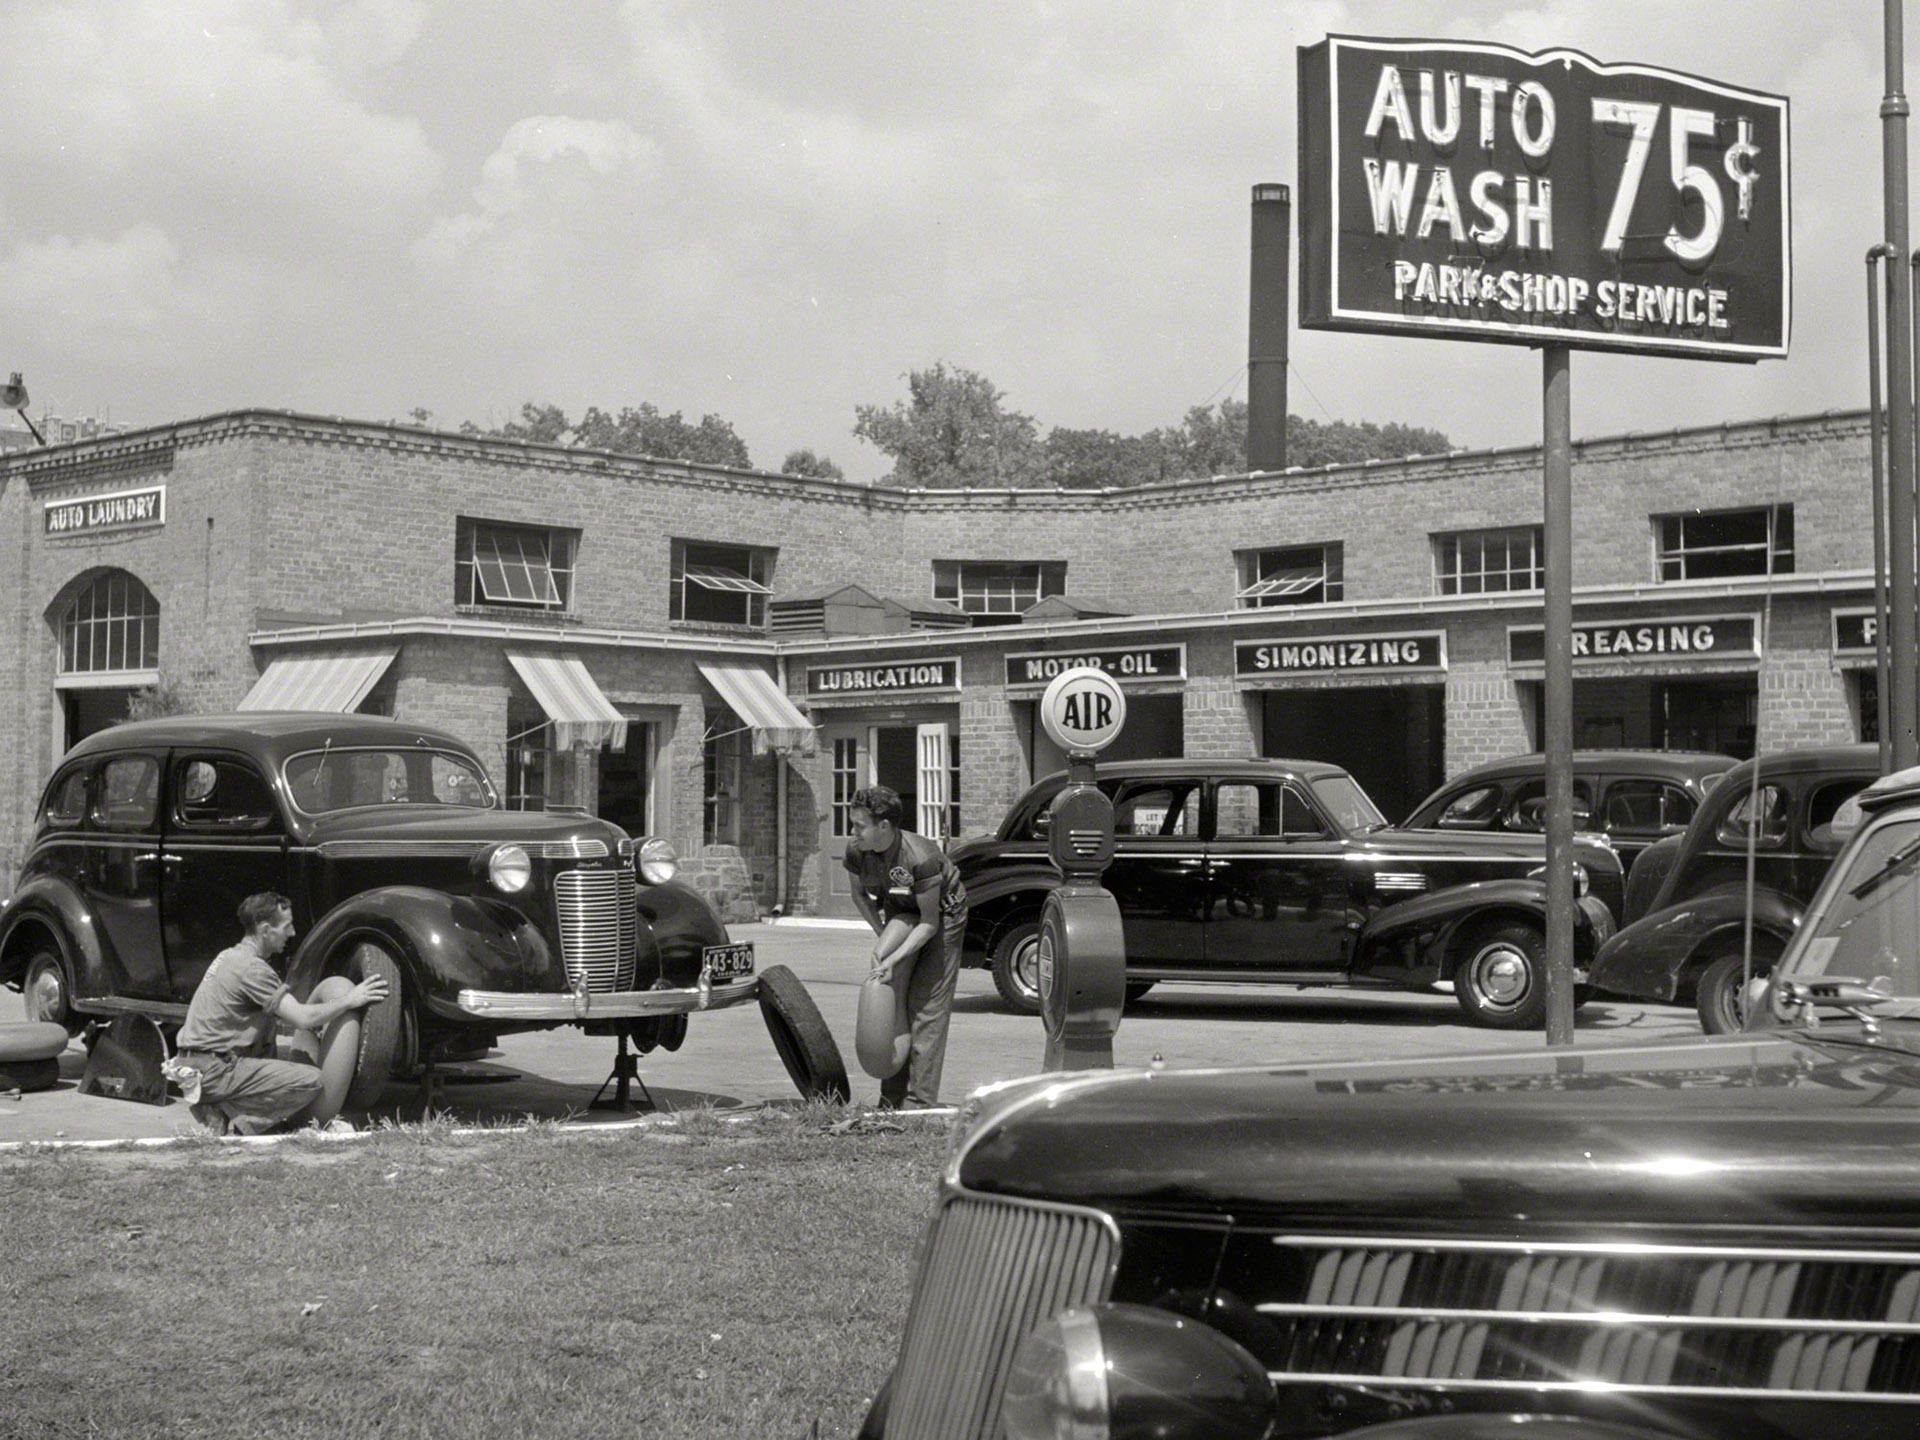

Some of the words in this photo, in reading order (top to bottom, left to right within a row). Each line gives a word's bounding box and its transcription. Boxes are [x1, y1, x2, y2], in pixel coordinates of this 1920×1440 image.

[1364, 63, 1557, 157] AUTO
[1362, 157, 1555, 251] WASH
[1595, 280, 1728, 328] SERVICE
[49, 506, 84, 531] AUTO
[88, 495, 156, 525] LAUNDRY
[1254, 641, 1420, 669] SIMONIZING
[1571, 625, 1715, 655] REASING
[818, 666, 943, 690] LUBRICATION
[1062, 691, 1113, 731] AIR
